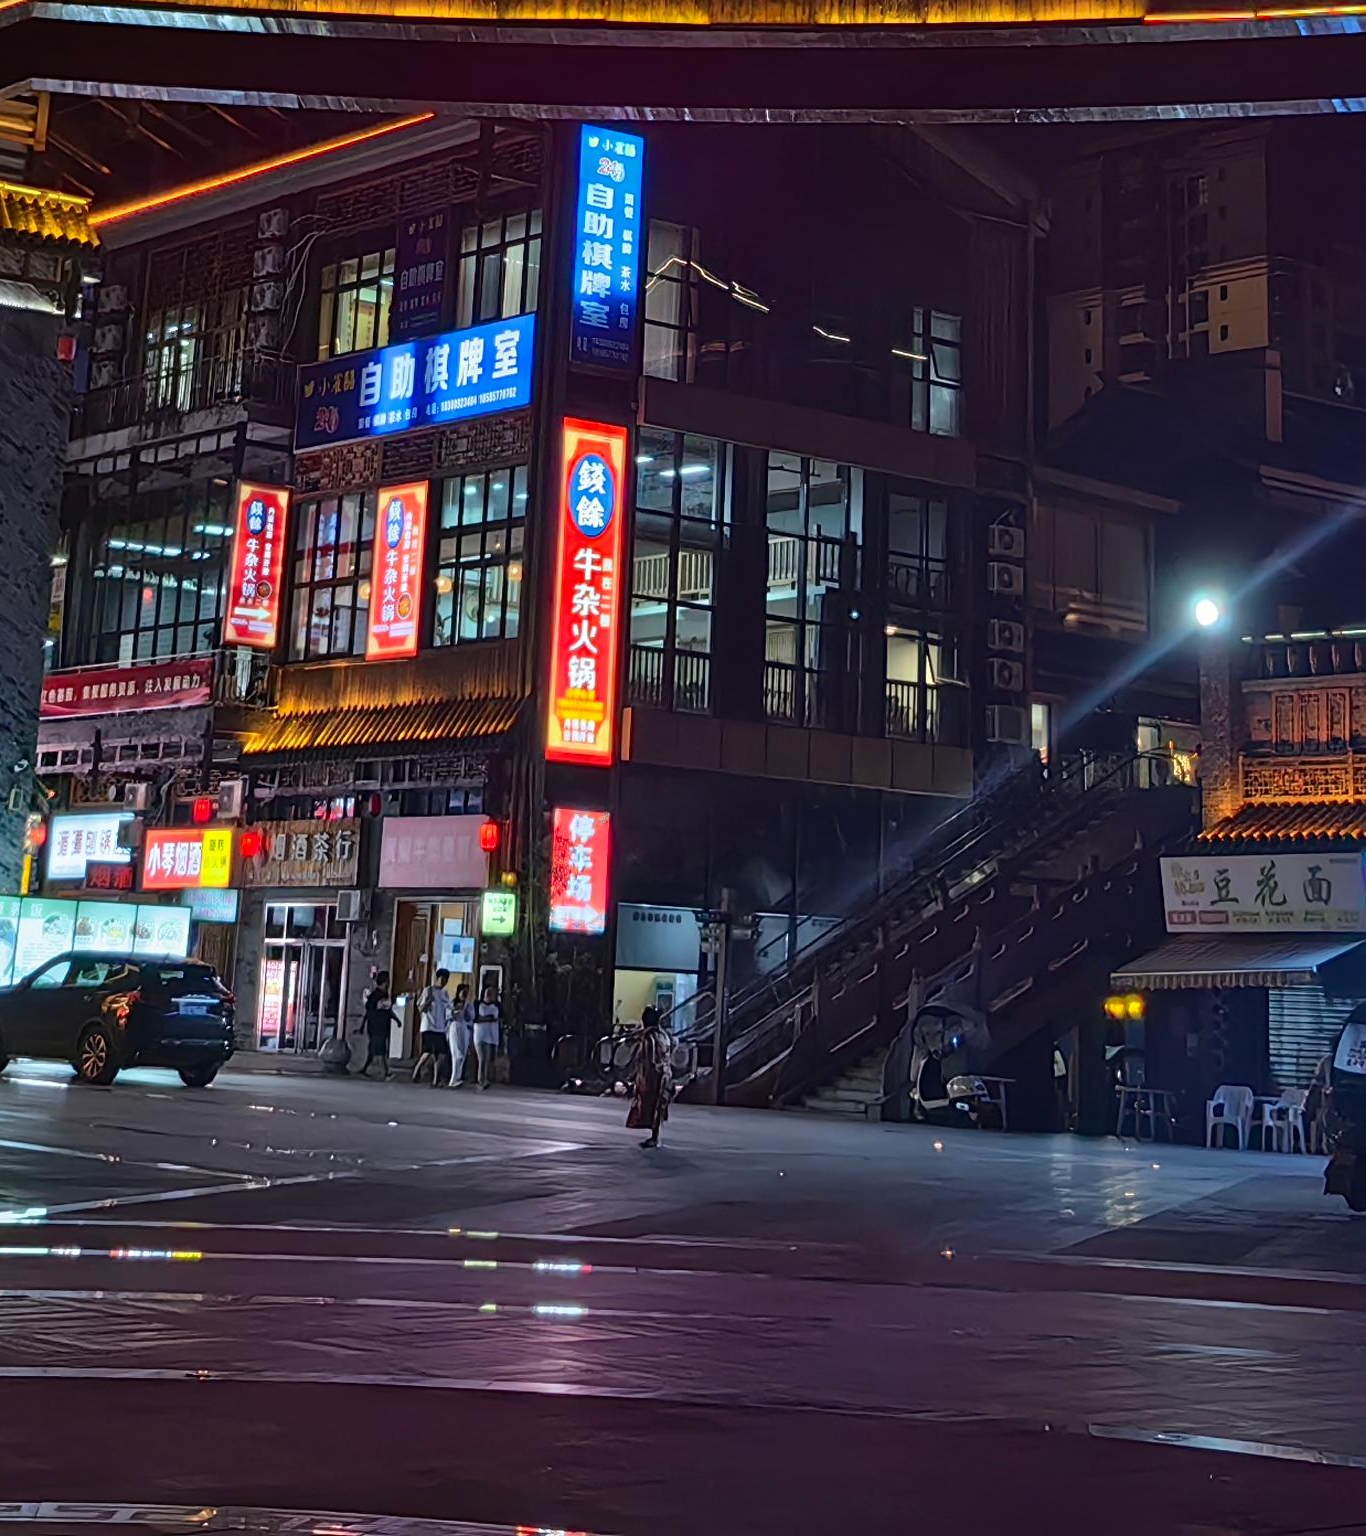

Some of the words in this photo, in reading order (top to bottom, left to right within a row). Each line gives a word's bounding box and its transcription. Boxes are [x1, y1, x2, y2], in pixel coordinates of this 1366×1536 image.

[579, 182, 615, 329] 自助棋牌室
[620, 266, 632, 292] 茶水
[358, 329, 521, 407] 自助棋牌室
[242, 538, 260, 598] 牛杂火锅
[381, 549, 399, 622] 牛杂火锅
[567, 547, 603, 690] 牛杂火锅
[89, 865, 134, 889] 烟酒
[147, 840, 203, 878] 小琴烟酒
[566, 814, 596, 902] 停车场
[1210, 860, 1332, 906] 豆花面
